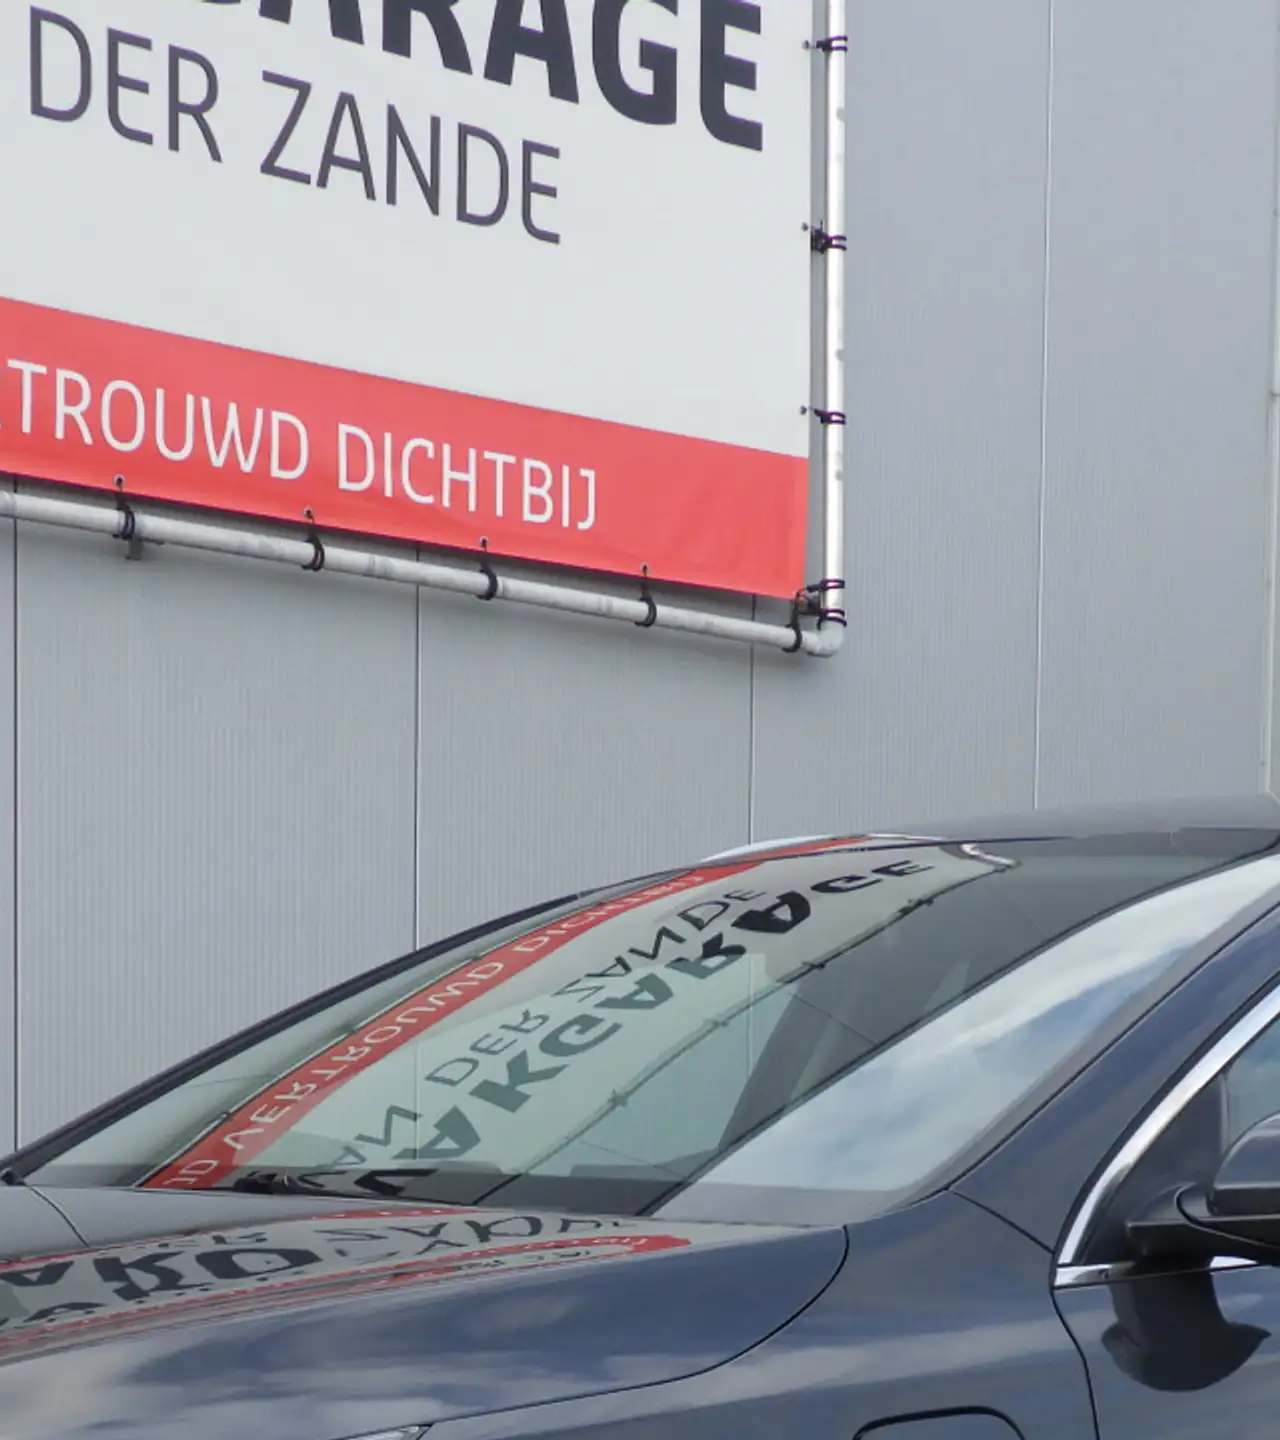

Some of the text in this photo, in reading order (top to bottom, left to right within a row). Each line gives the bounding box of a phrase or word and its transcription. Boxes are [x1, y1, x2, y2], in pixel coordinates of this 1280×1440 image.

[29, 5, 223, 164] DER
[260, 69, 561, 246] ZANDE
[337, 422, 597, 530] DICHTBIJ
